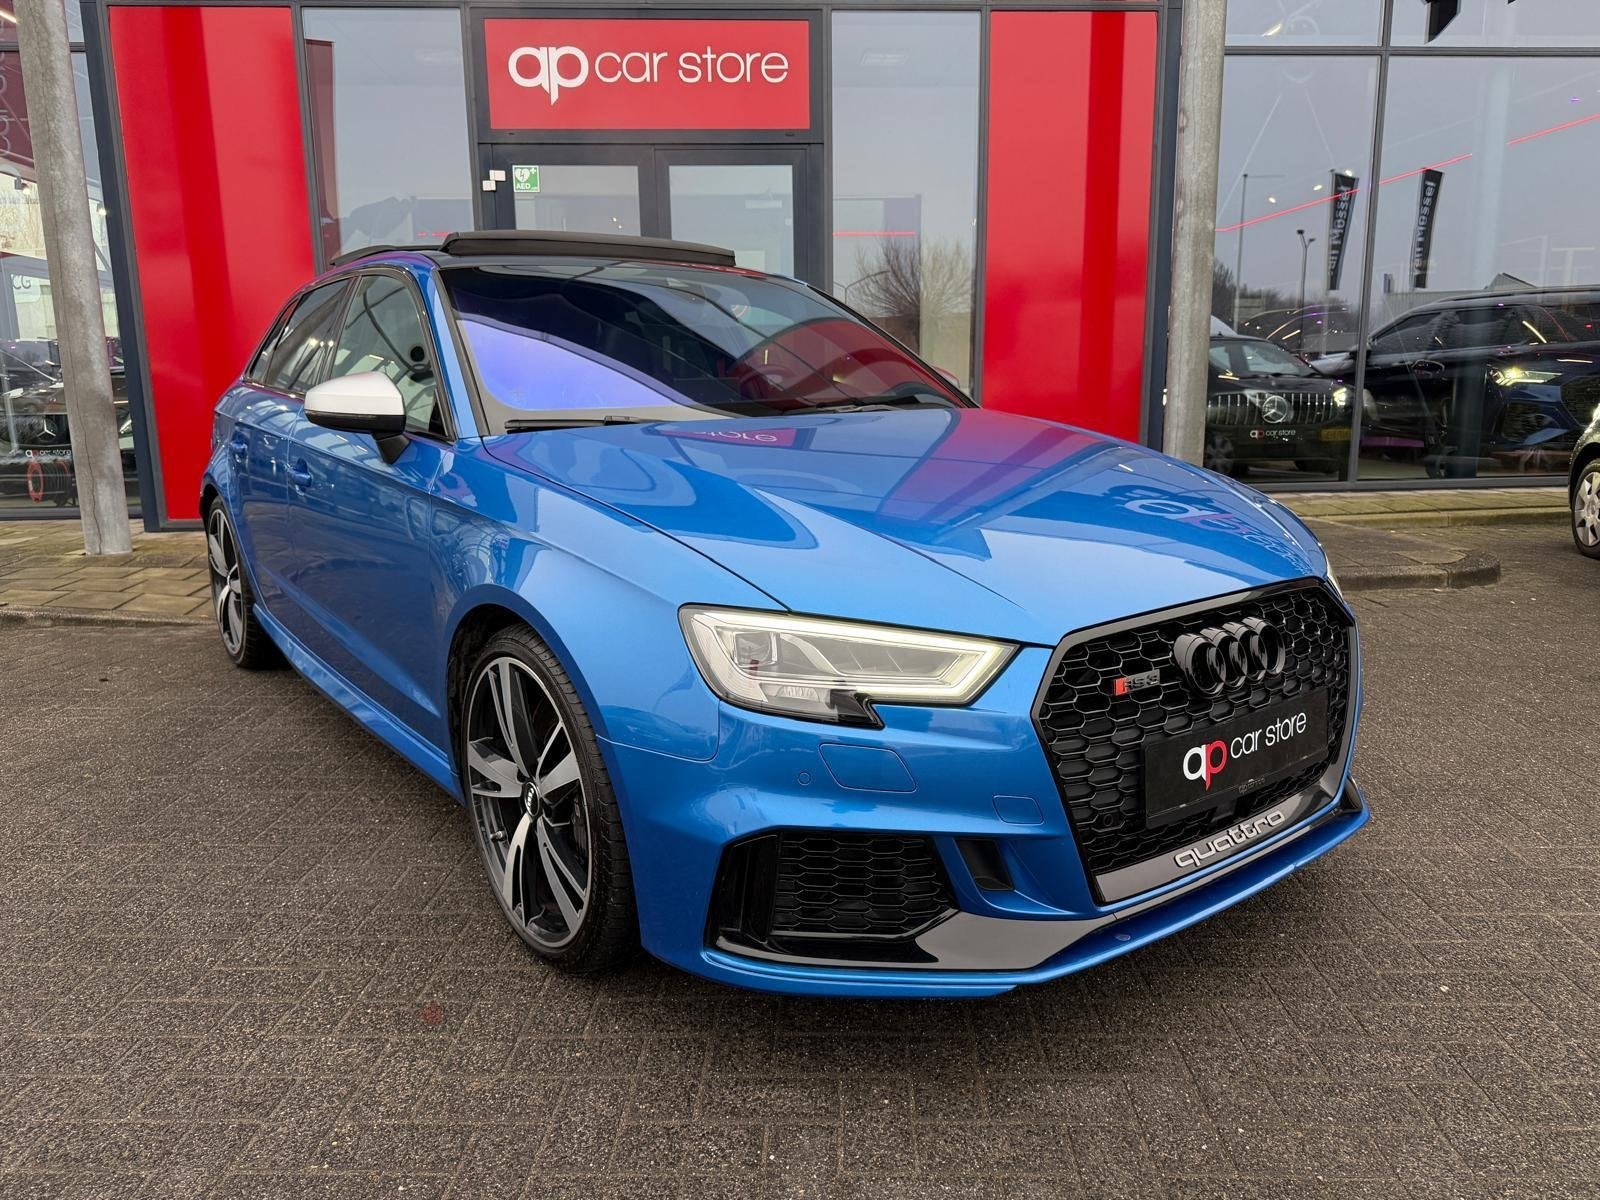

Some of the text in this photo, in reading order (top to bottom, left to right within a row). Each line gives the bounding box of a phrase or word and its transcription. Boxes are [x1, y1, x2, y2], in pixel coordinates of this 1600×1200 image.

[595, 51, 668, 83] car
[678, 46, 789, 83] store
[1231, 729, 1262, 759] car
[1265, 712, 1307, 747] store
[1174, 810, 1286, 868] quattro
